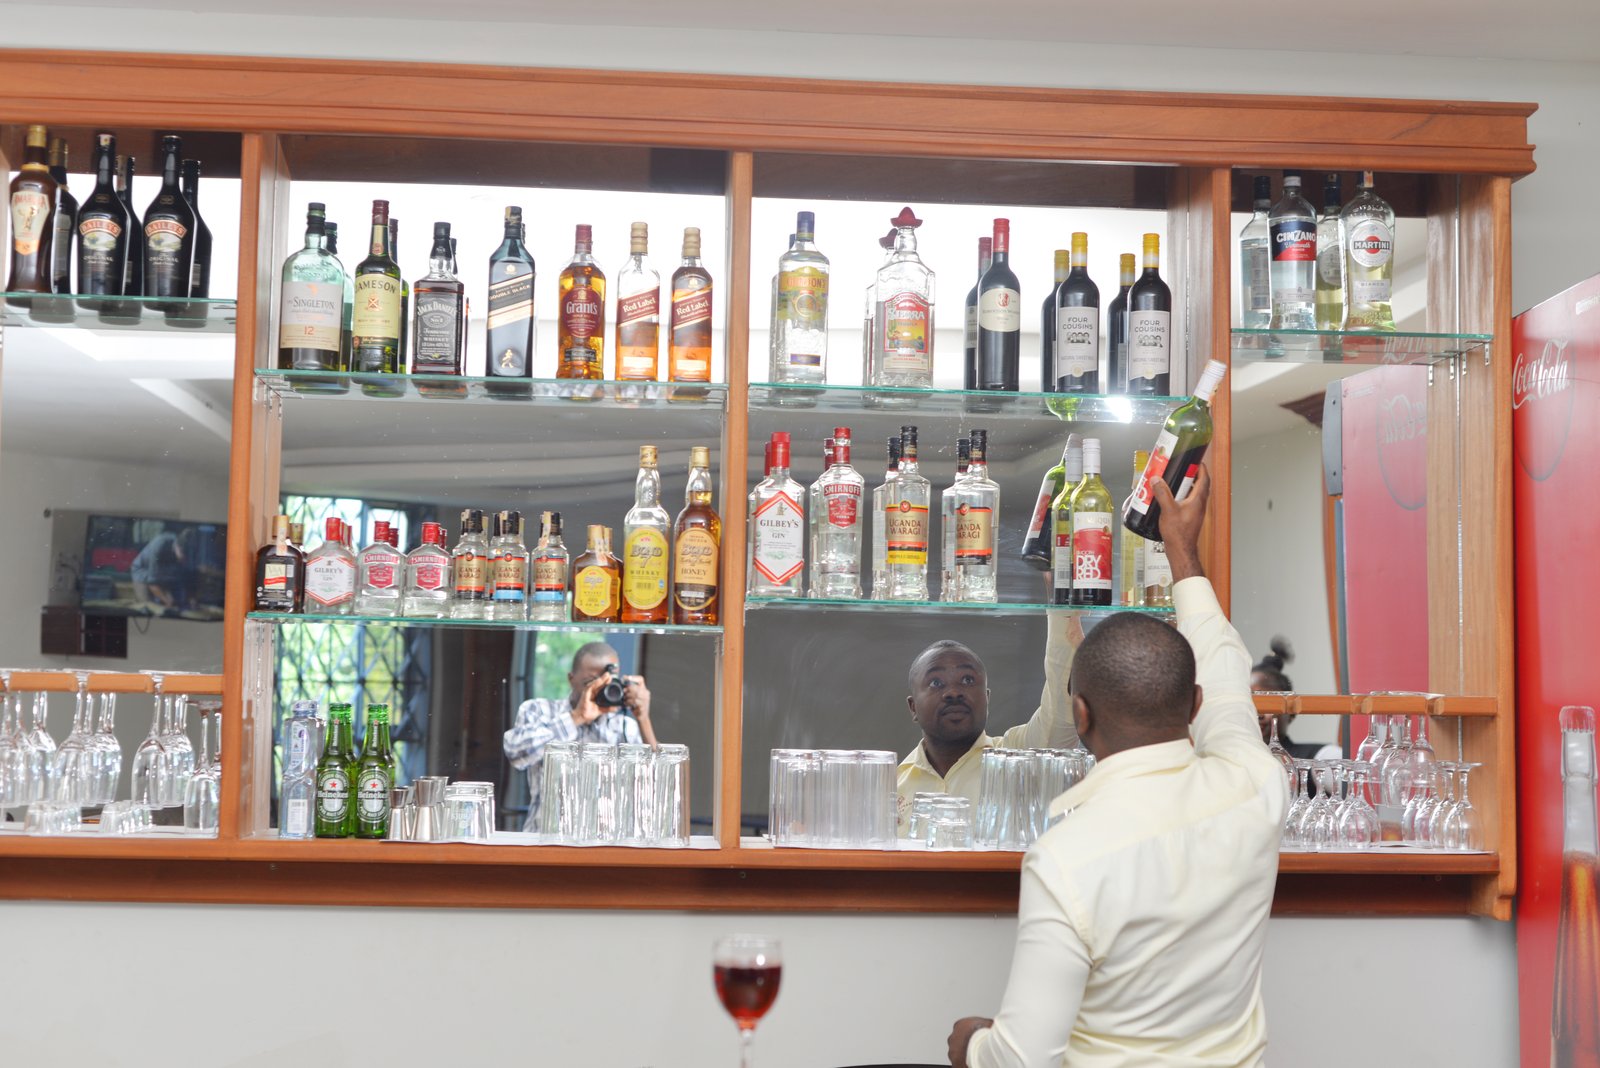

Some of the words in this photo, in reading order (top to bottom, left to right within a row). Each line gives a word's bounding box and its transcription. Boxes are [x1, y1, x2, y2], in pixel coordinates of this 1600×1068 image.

[81, 220, 119, 234] BAILEYS
[147, 221, 186, 234] BAILEYS
[1276, 230, 1316, 243] CINZANO
[1354, 241, 1390, 250] MARTINI
[292, 296, 336, 310] SINGLETON
[565, 302, 598, 315] Grant's
[623, 301, 638, 313] Red
[639, 297, 656, 309] Label
[676, 303, 692, 316] Red
[693, 299, 708, 312] Label
[417, 303, 433, 316] JACK
[304, 326, 314, 336] 12
[1513, 338, 1569, 410] Coca-Cola
[824, 484, 861, 496] SMIRNOFF
[760, 518, 800, 529] GILBEY'S
[889, 519, 921, 528] UGANDA
[772, 532, 786, 540] GIN
[890, 527, 921, 536] WARAGI
[1076, 554, 1102, 568] DRY
[314, 566, 344, 574] GILBEY'S
[681, 568, 706, 576] HONEY
[1076, 567, 1101, 580] RED
[317, 790, 349, 799] Heineken
[357, 790, 388, 799] Heineken
